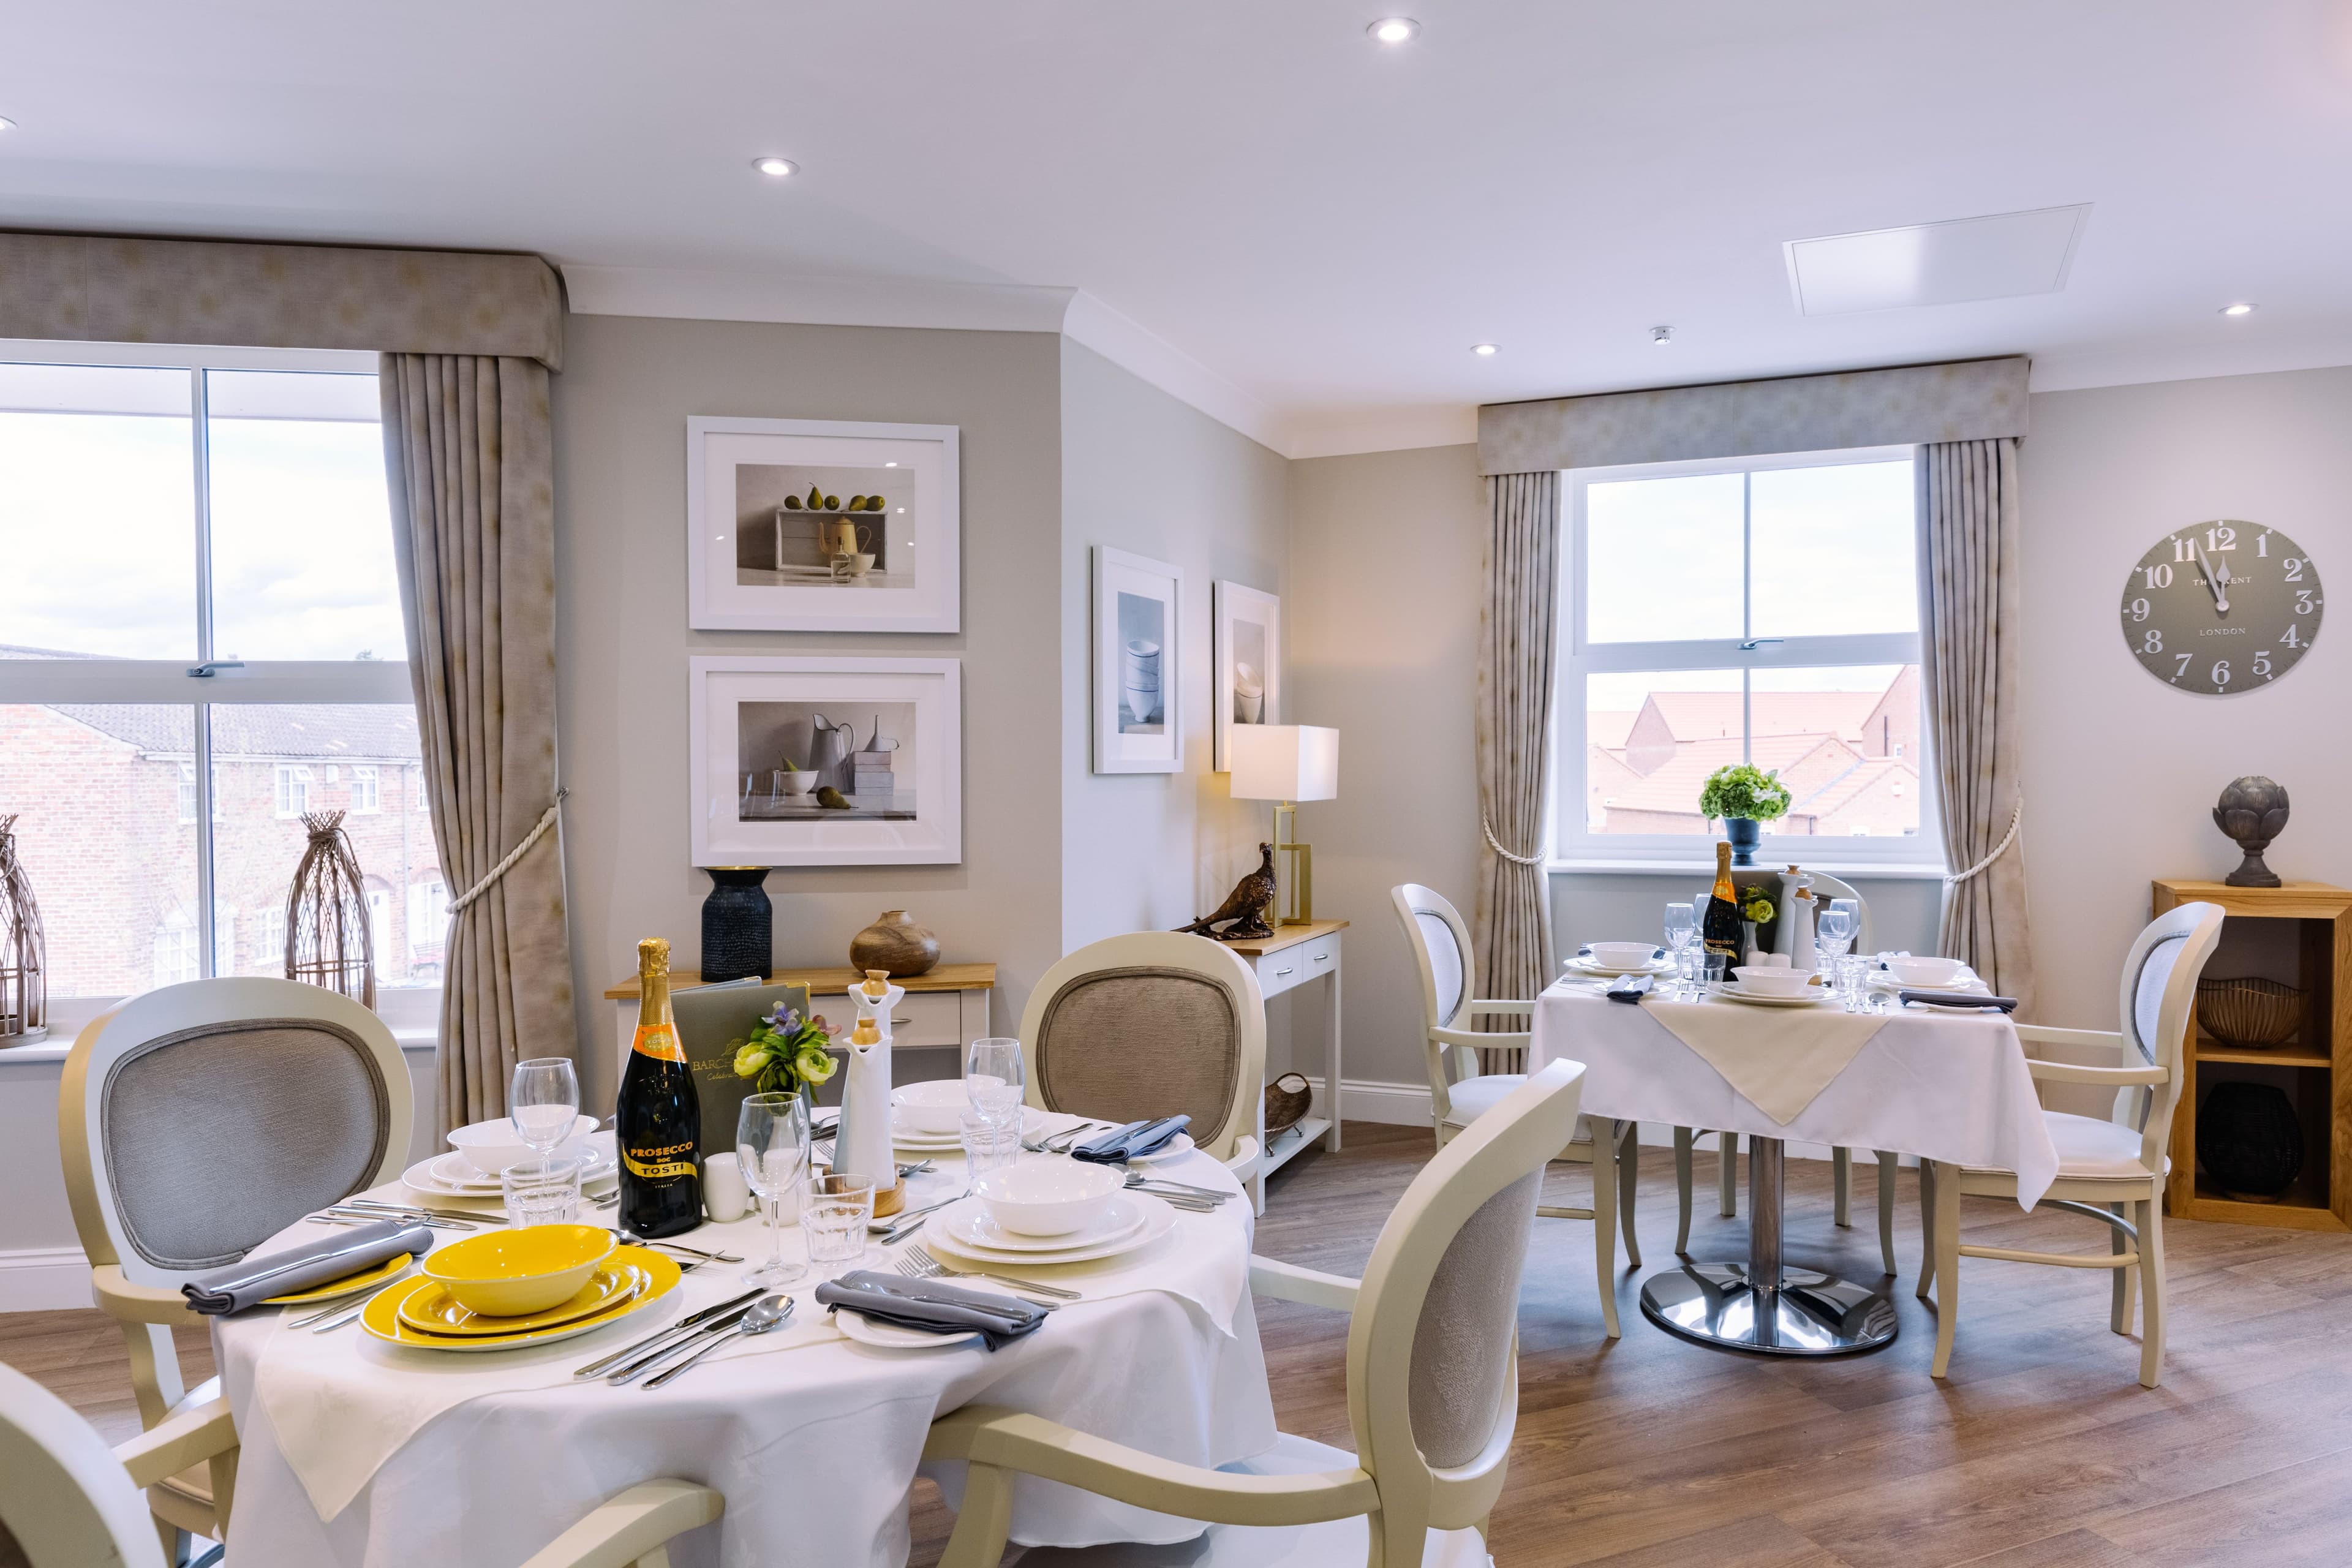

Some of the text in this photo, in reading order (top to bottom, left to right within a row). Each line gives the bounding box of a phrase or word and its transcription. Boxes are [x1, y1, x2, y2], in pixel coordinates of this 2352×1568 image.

[2173, 538, 2196, 562] 11
[2206, 527, 2236, 551] 12
[2256, 534, 2268, 557] 1
[2144, 564, 2173, 589] 10
[2284, 559, 2302, 582] 2
[2132, 598, 2150, 622] 9
[2295, 590, 2313, 614] 3
[2144, 630, 2163, 654] 8
[2280, 624, 2299, 648] 4
[2176, 654, 2193, 676] 7
[2212, 661, 2230, 685] 6
[2253, 651, 2271, 675] 5
[630, 1141, 693, 1156] PROSECCO
[641, 1163, 684, 1175] TOSTI
